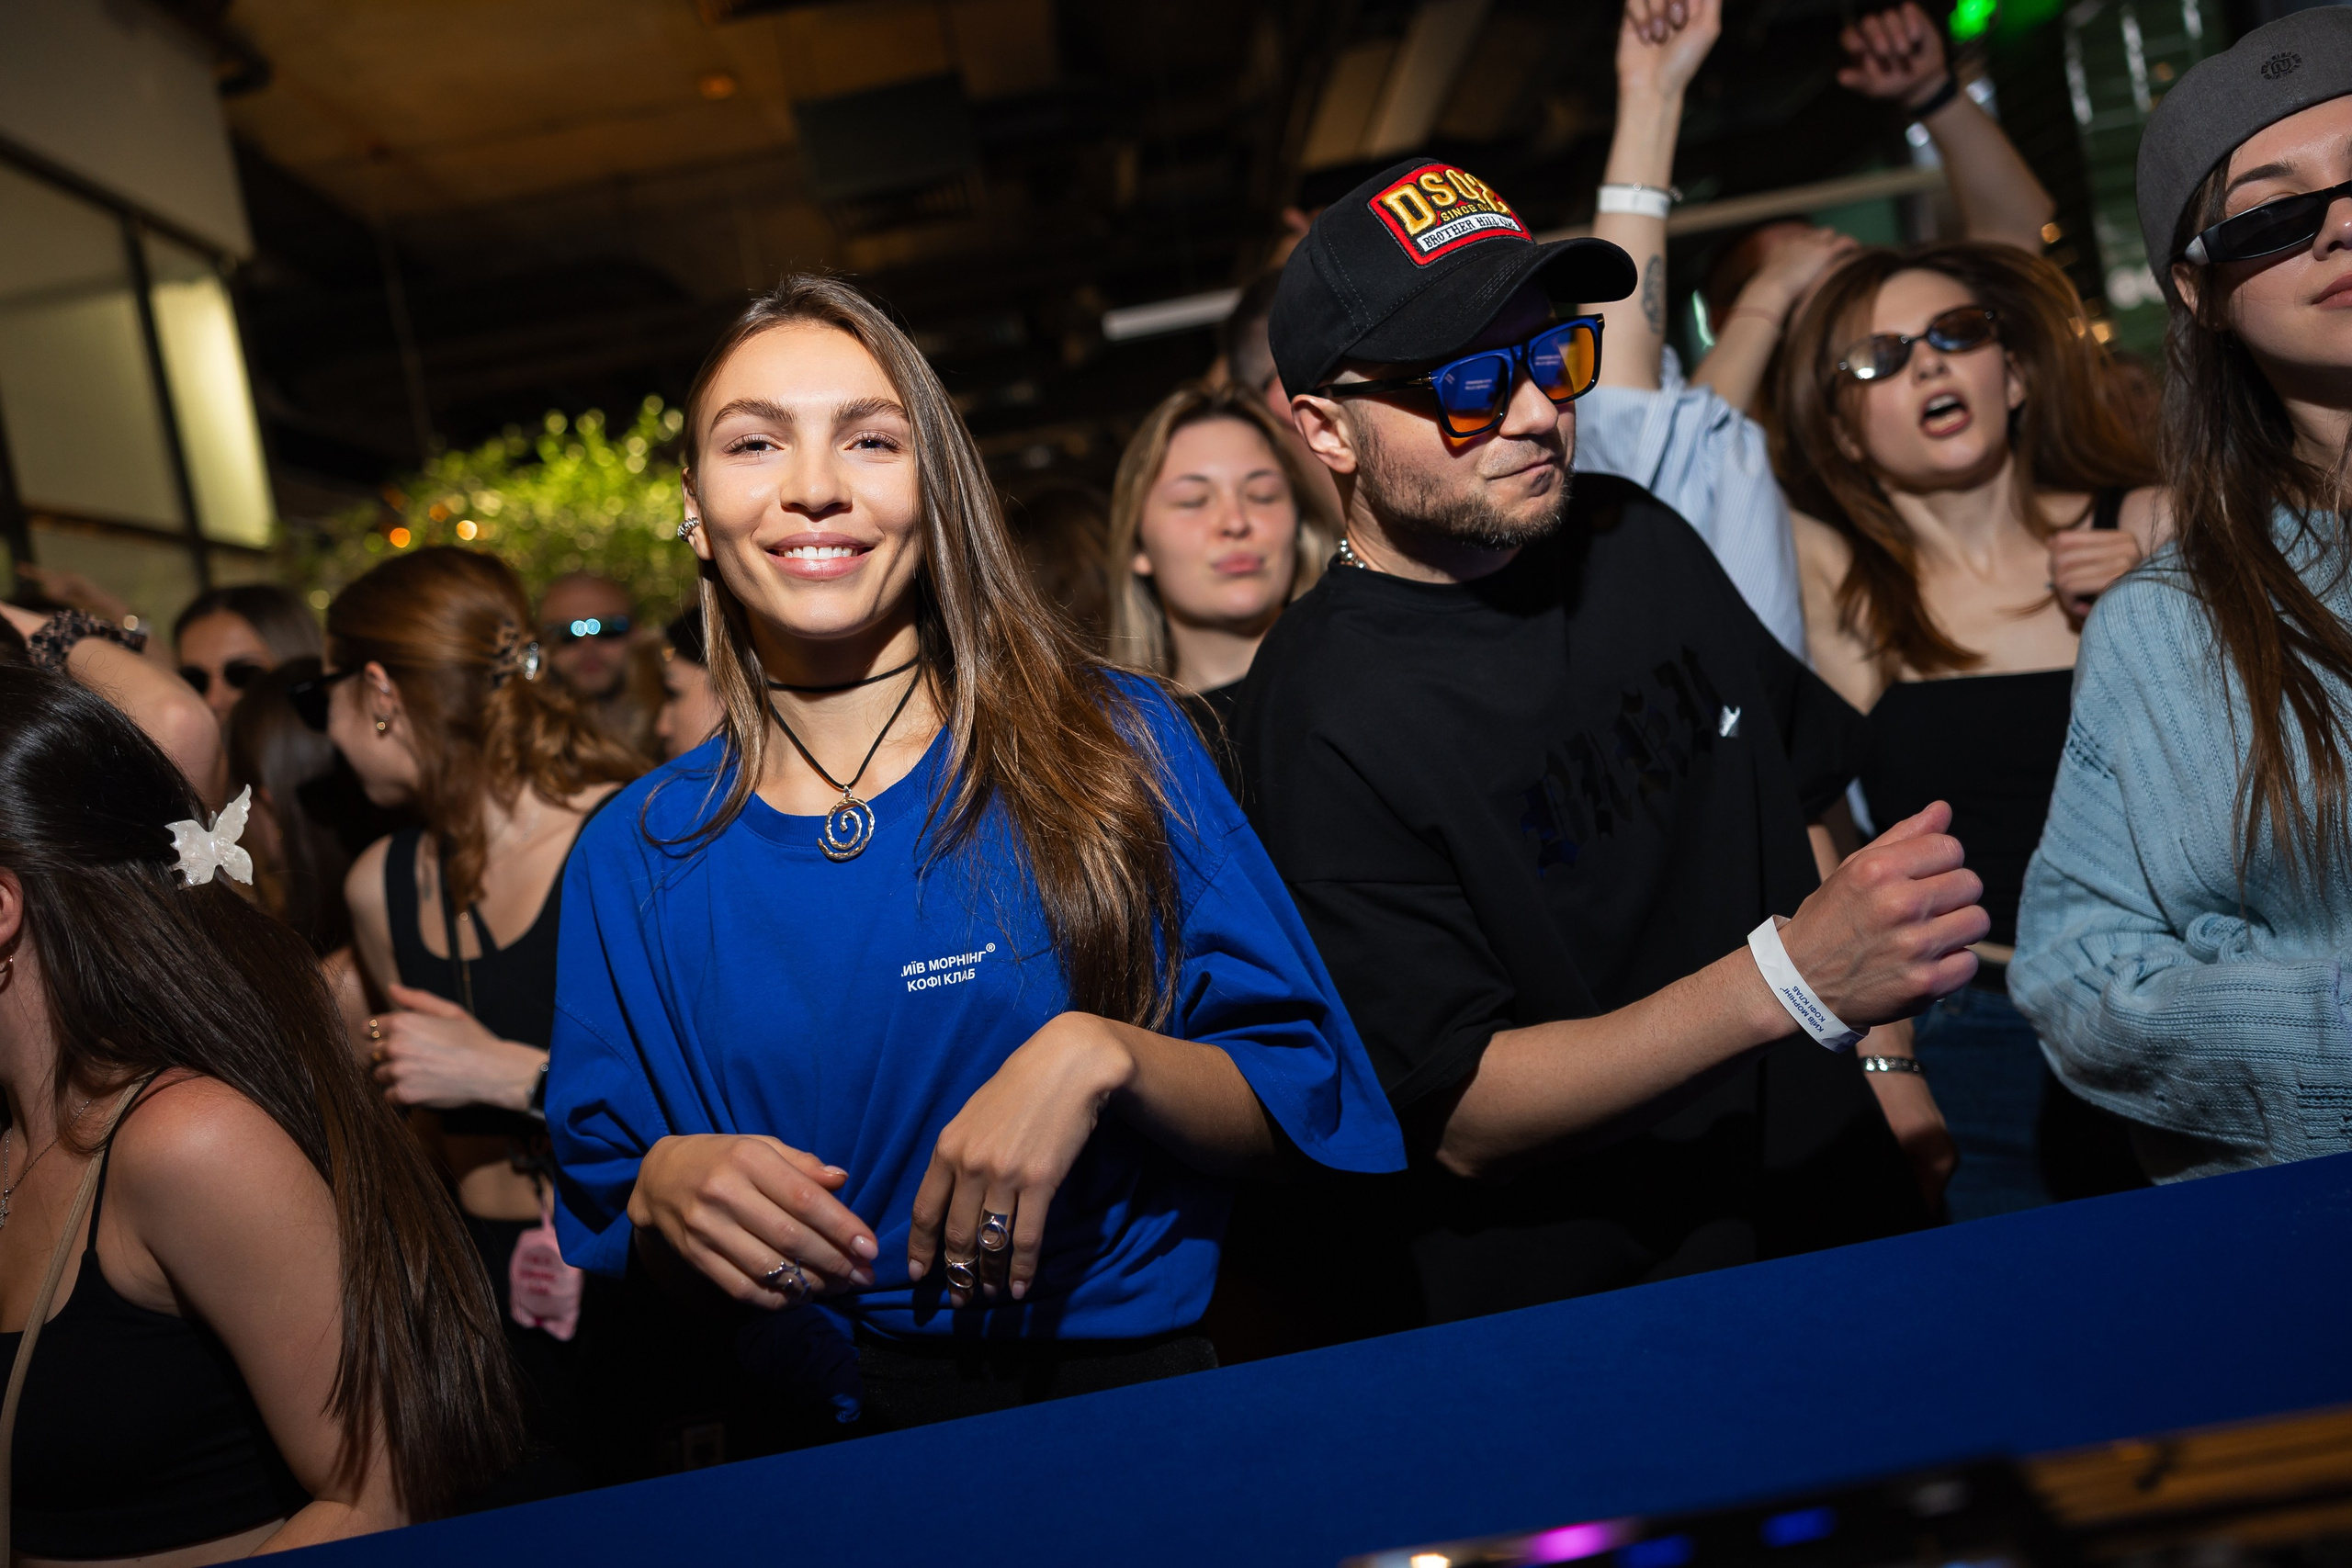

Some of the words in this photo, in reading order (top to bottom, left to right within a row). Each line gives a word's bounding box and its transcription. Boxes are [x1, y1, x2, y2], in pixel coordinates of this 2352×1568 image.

[1441, 204, 1477, 222] SINCE
[1422, 219, 1476, 248] BROTHER
[900, 961, 926, 977] ИЇВ
[907, 975, 942, 992] КОФІ
[944, 968, 976, 986] КЛАБ
[1792, 986, 1810, 1005] КЛАБ
[1807, 1004, 1826, 1022] КОФІ
[1807, 1016, 1825, 1033] КИЇВ
